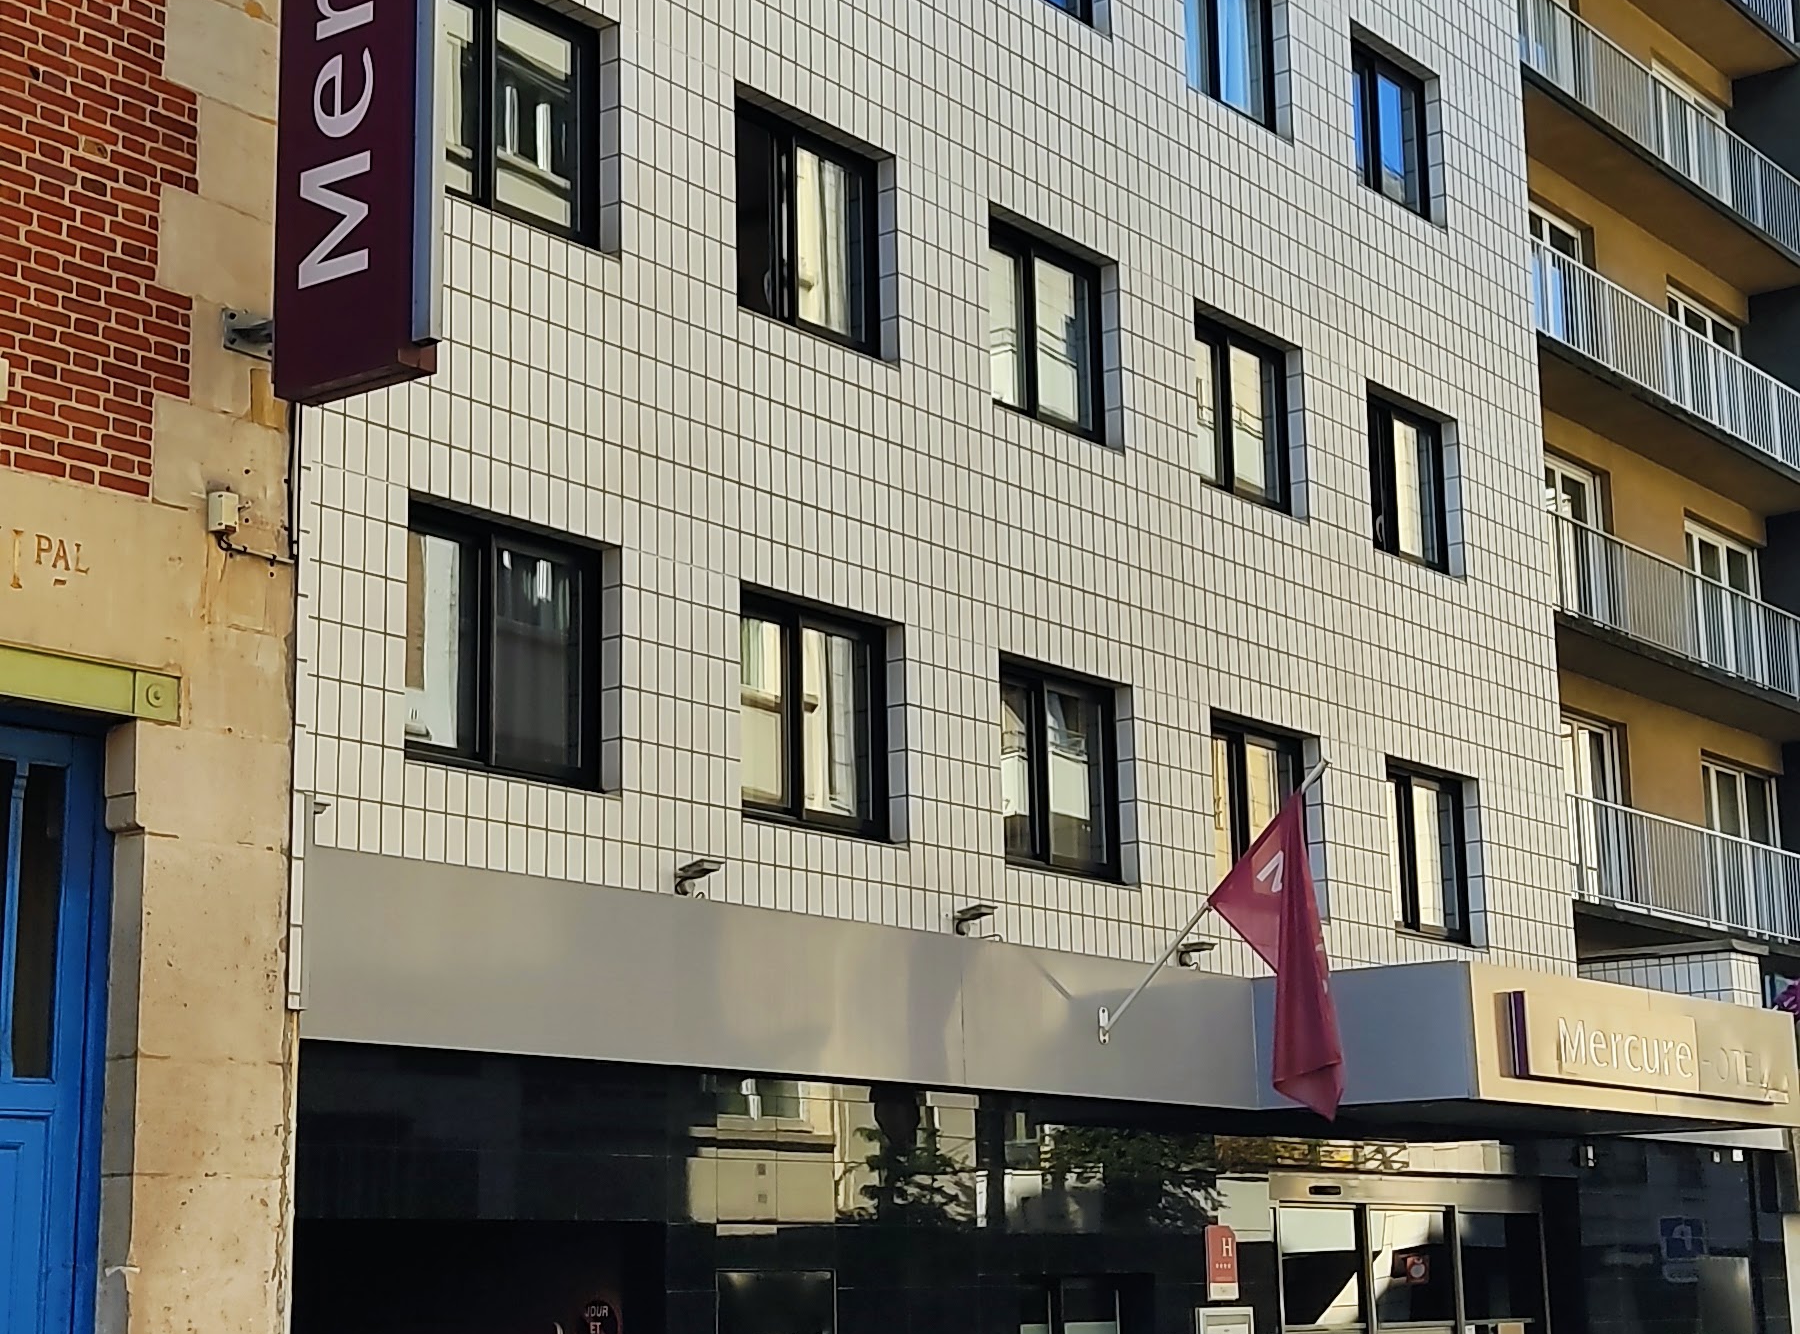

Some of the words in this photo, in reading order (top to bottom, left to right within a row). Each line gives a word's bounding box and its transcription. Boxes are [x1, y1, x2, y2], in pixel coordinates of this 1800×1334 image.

[1557, 1016, 1694, 1079] Mercure
[1221, 1237, 1233, 1257] H
[585, 1305, 609, 1317] JOUR
[590, 1322, 602, 1334] ET
